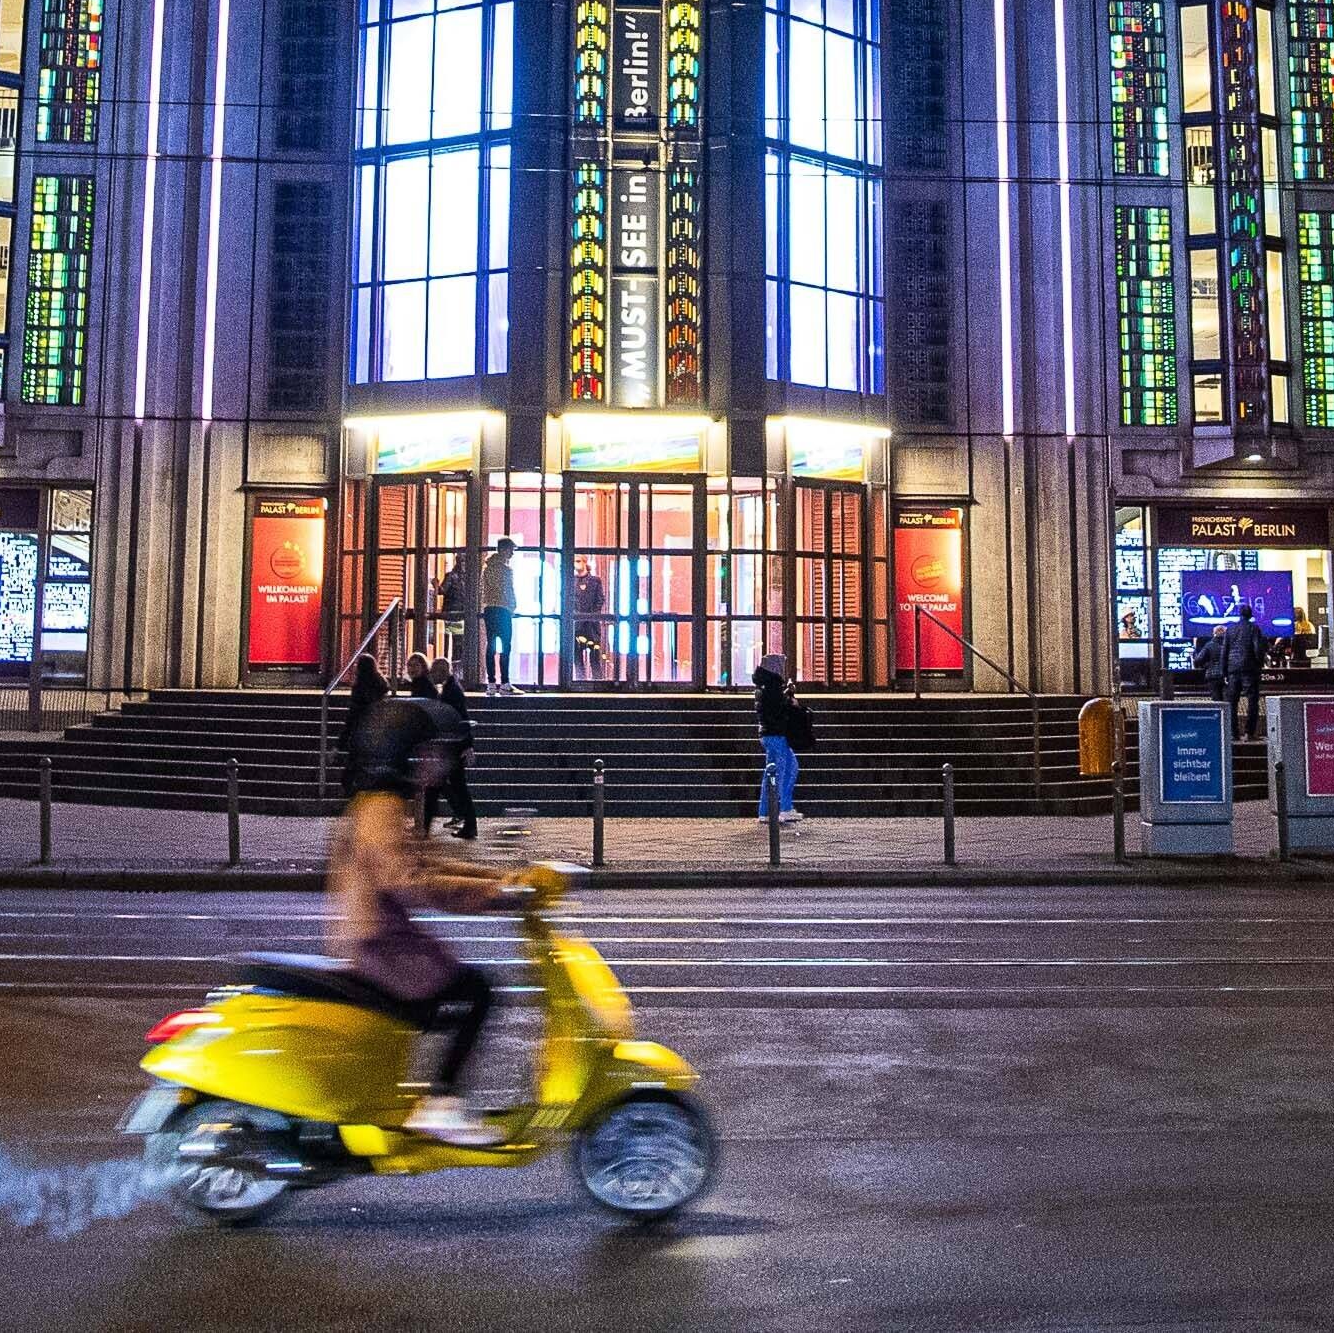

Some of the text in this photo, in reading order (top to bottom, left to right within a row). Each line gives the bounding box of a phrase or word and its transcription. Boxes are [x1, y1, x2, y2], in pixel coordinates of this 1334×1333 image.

[620, 175, 647, 203] in
[899, 517, 924, 525] PALAST
[1192, 524, 1296, 537] PALAST BERLIN
[258, 585, 317, 595] WILLKOMMEN
[266, 594, 309, 603] IM PALAST
[907, 593, 949, 603] WELCOME
[899, 603, 910, 612] TO
[929, 603, 957, 612] PALAST
[1177, 746, 1207, 756] Immer
[1173, 759, 1211, 769] sichtbar
